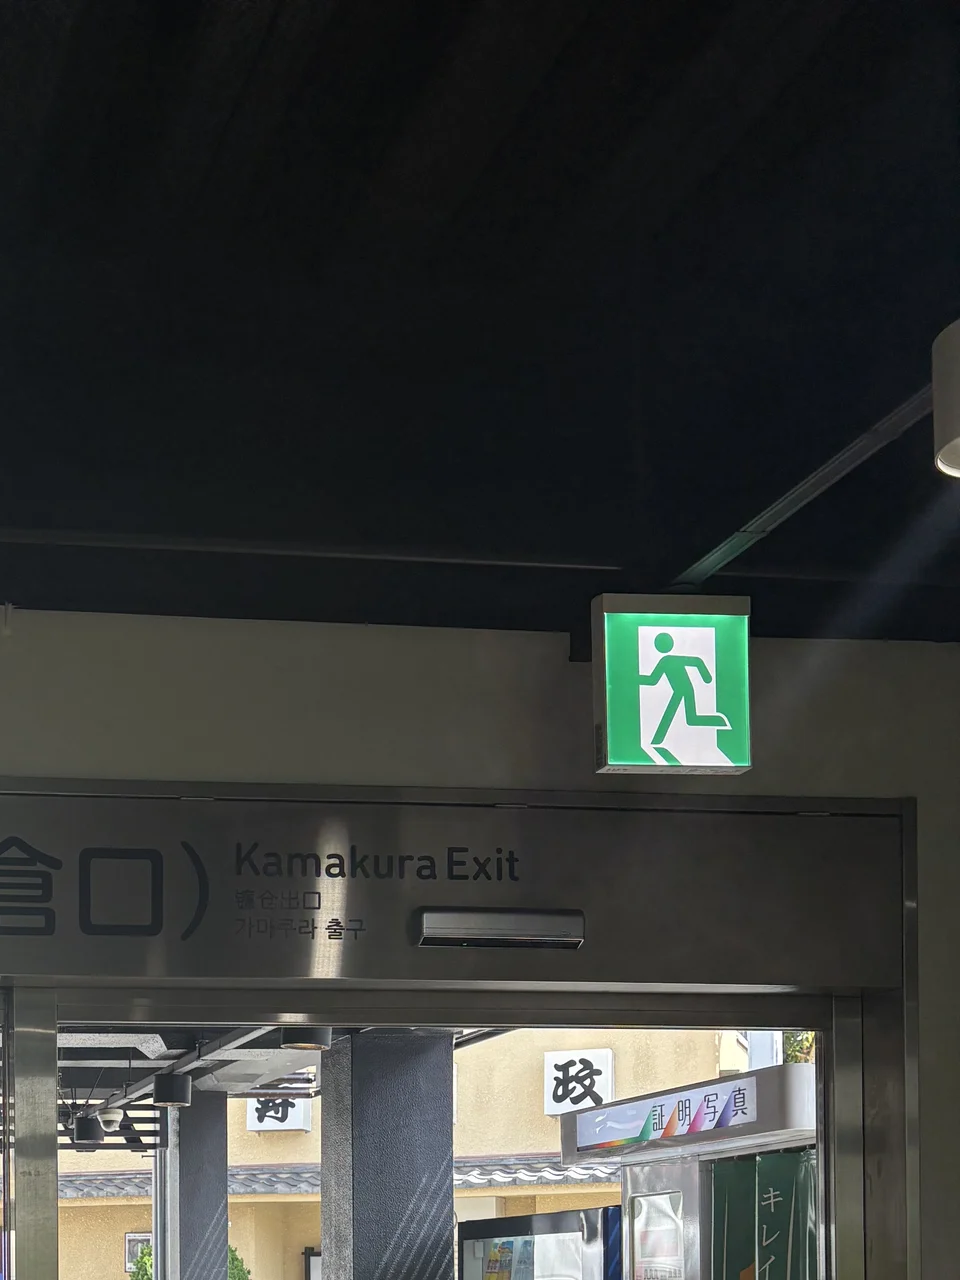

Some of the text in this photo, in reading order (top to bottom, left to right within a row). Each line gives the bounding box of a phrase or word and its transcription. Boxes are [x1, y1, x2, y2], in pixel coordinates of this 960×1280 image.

[235, 842, 520, 881] Kamakura Exit
[325, 918, 367, 940] 출구
[651, 1087, 748, 1132] 証明写真
